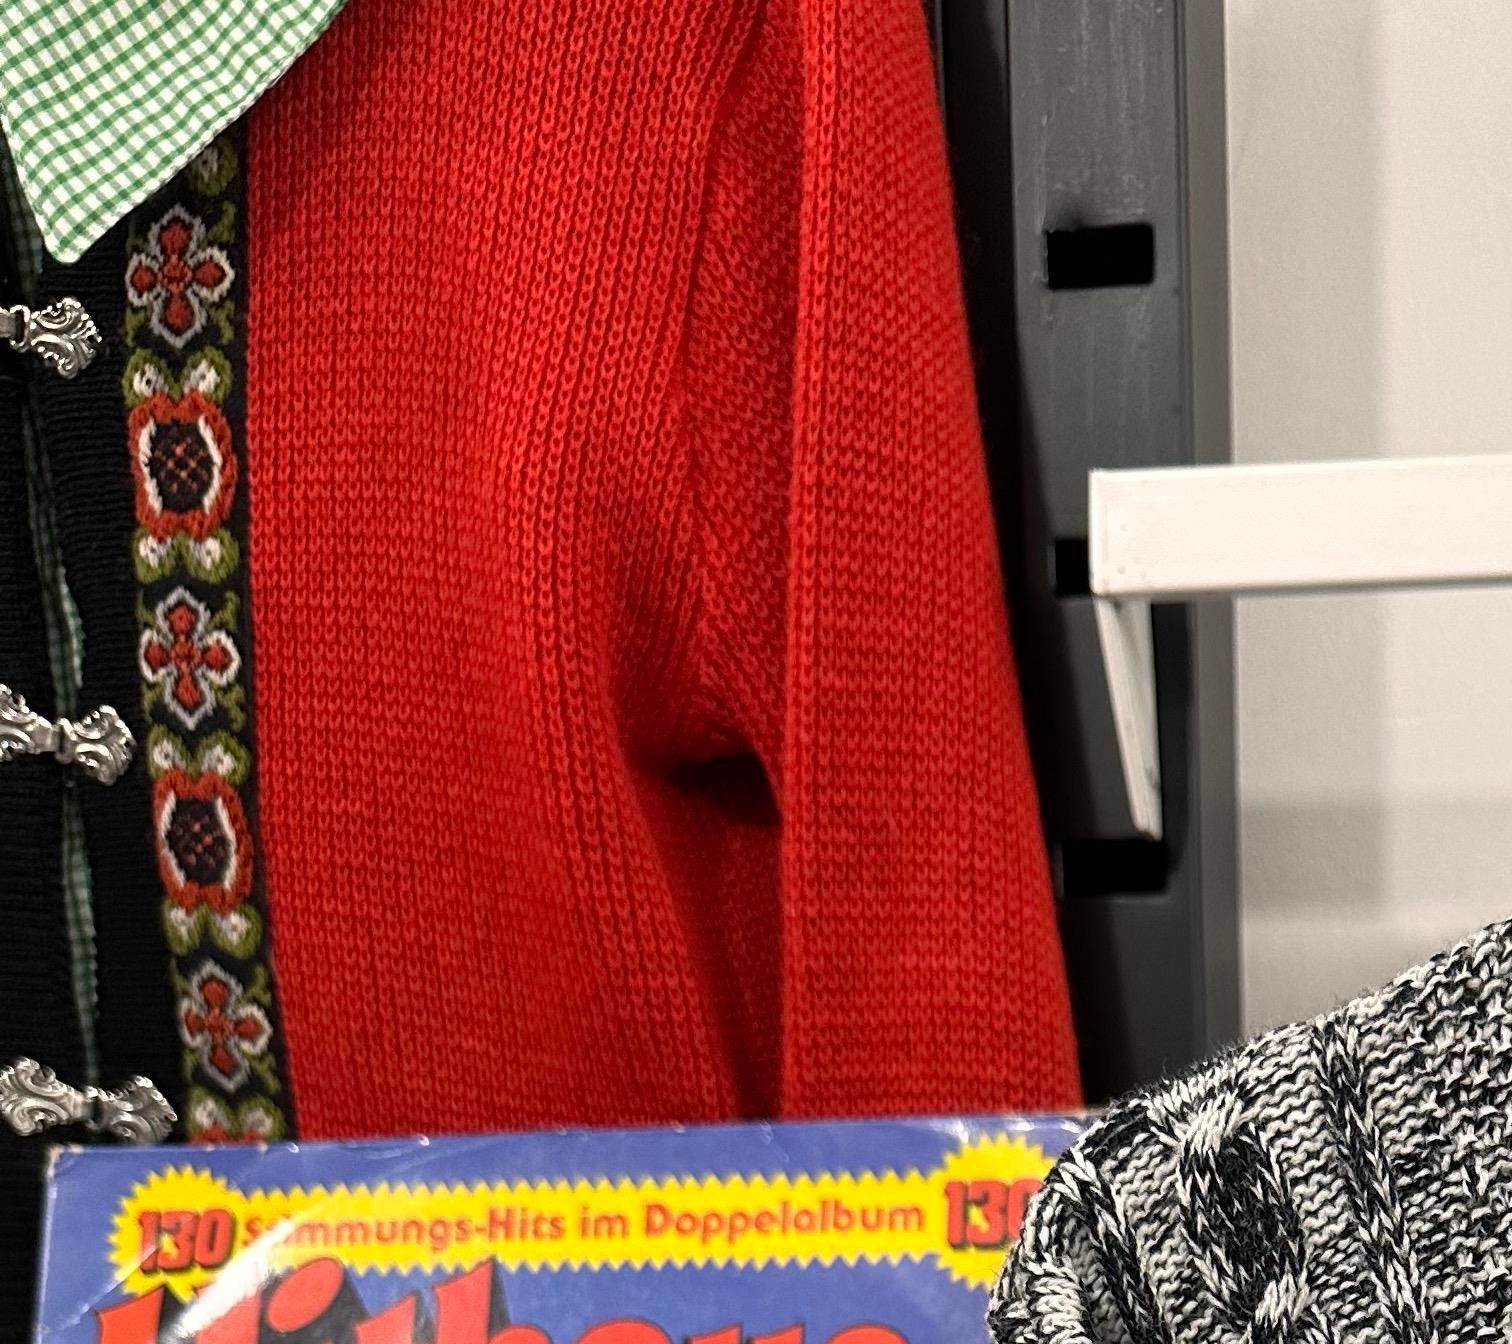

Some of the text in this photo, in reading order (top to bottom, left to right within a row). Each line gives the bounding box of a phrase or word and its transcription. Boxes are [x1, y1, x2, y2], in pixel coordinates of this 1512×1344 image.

[138, 1208, 236, 1273] 130
[244, 1204, 564, 1254] Smmungs-Hits
[579, 1205, 629, 1240] im
[644, 1199, 926, 1247] Doppelalbum
